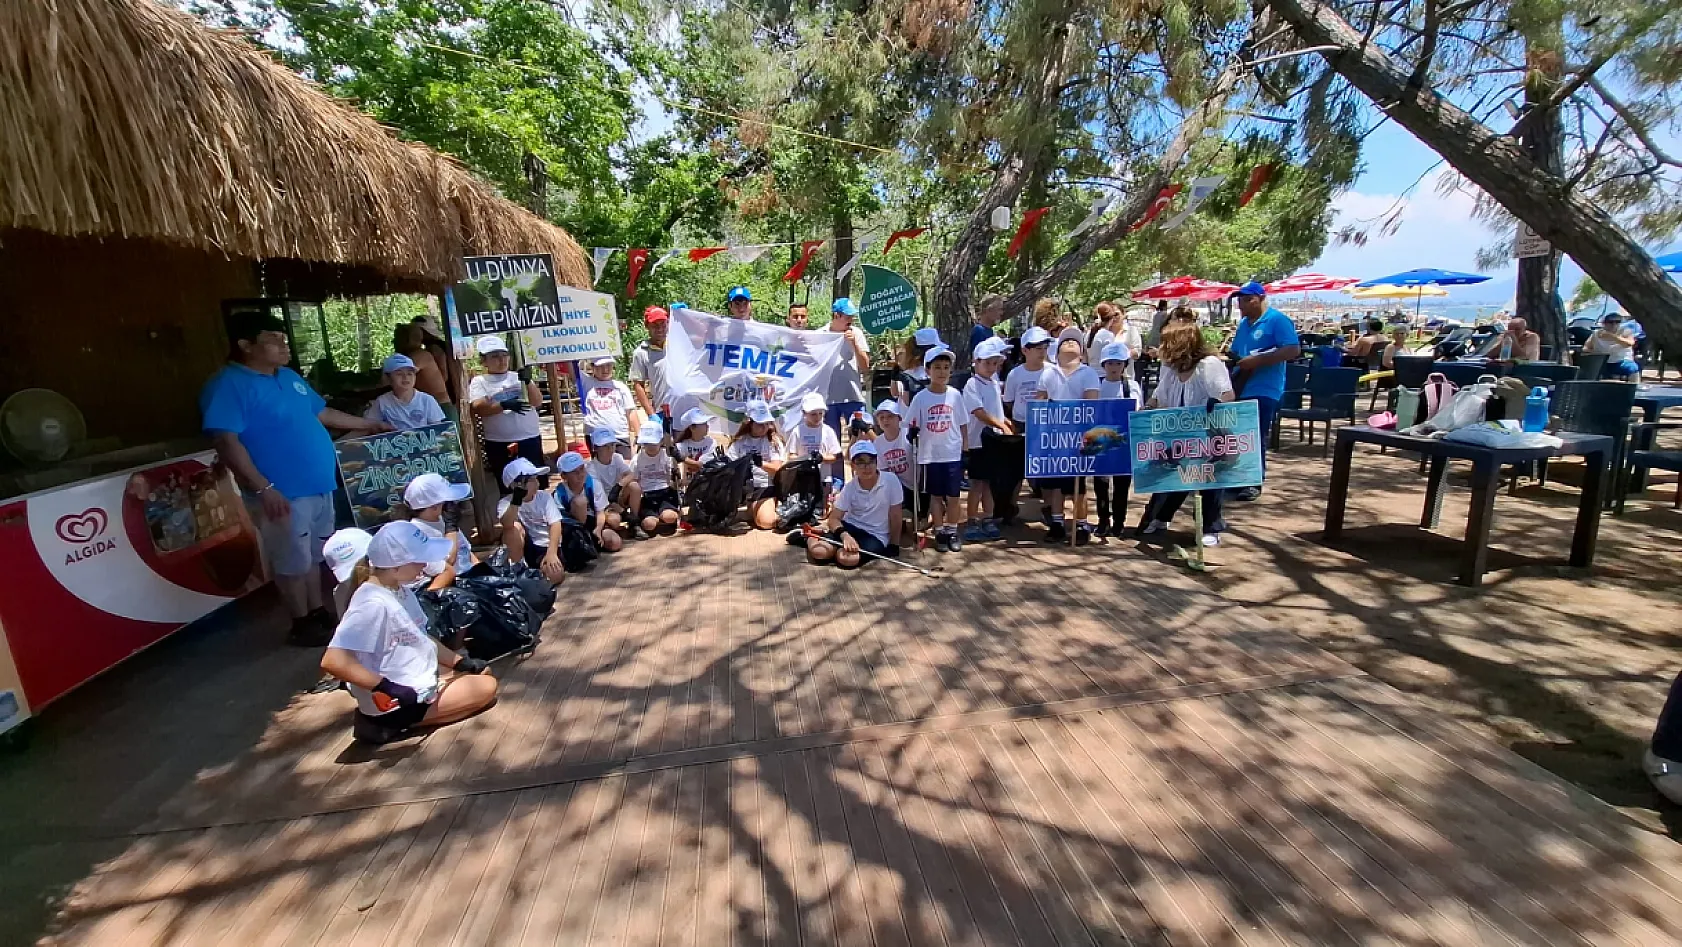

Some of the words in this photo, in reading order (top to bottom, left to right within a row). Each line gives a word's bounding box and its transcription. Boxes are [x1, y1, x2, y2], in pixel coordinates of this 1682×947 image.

[463, 261, 480, 282] U
[485, 256, 550, 282] DÜNYA
[558, 295, 573, 303] ZEL
[861, 291, 915, 313] KURTARACAK
[870, 285, 903, 301] DOĞAYI
[465, 301, 558, 334] HEPİMİZİN
[561, 309, 591, 320] THİYE
[871, 310, 911, 328] SİZSİNİZ
[878, 304, 901, 317] OLAN
[542, 324, 598, 338] İLKOKULU
[538, 340, 606, 356] ORTAOKULU
[1031, 403, 1070, 425] TEMİZ
[1073, 402, 1095, 424] BİR
[1151, 407, 1238, 434] DOĞANIN
[1040, 428, 1085, 450] DÜNYA
[1136, 438, 1168, 462] BİR
[1171, 429, 1256, 459] DENGESİ
[1028, 453, 1096, 475] İSTİYORUZ
[1178, 463, 1216, 484] VAR
